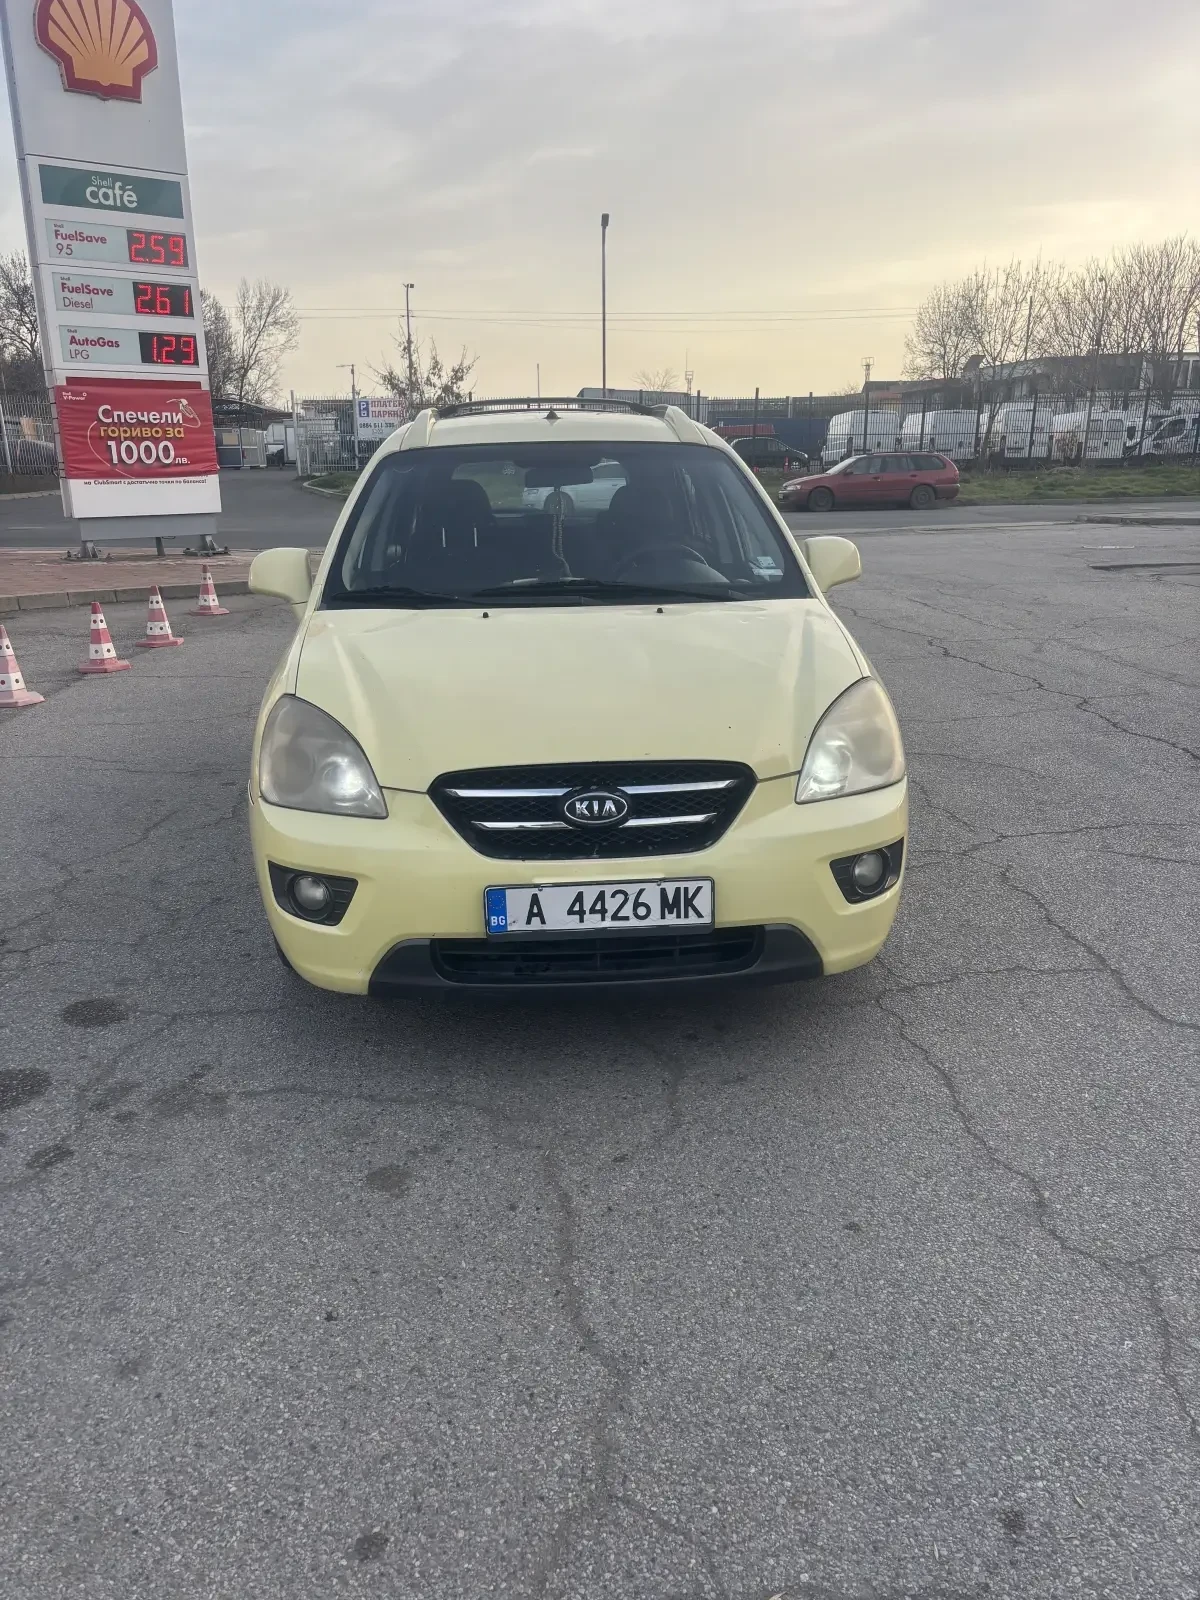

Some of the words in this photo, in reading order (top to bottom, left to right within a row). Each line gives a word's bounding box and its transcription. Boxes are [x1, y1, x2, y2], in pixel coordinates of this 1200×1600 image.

[92, 176, 113, 187] Shell
[86, 182, 138, 208] café
[54, 229, 107, 244] FuelSave
[56, 243, 73, 256] 95
[130, 232, 184, 265] 2.59
[61, 282, 114, 296] FuelSave
[62, 297, 93, 309] Diesel
[136, 284, 189, 315] 2.61
[69, 335, 120, 348] AutoGas
[152, 335, 195, 364] 1.29
[69, 349, 90, 360] LPG
[98, 404, 183, 424] Спечели
[100, 426, 162, 442] гориво
[165, 427, 185, 438] за
[107, 440, 175, 465] 1000
[574, 799, 618, 818] KIA
[490, 915, 506, 927] BG
[525, 892, 547, 926] A
[566, 887, 653, 924] 4426
[659, 885, 705, 921] MK
